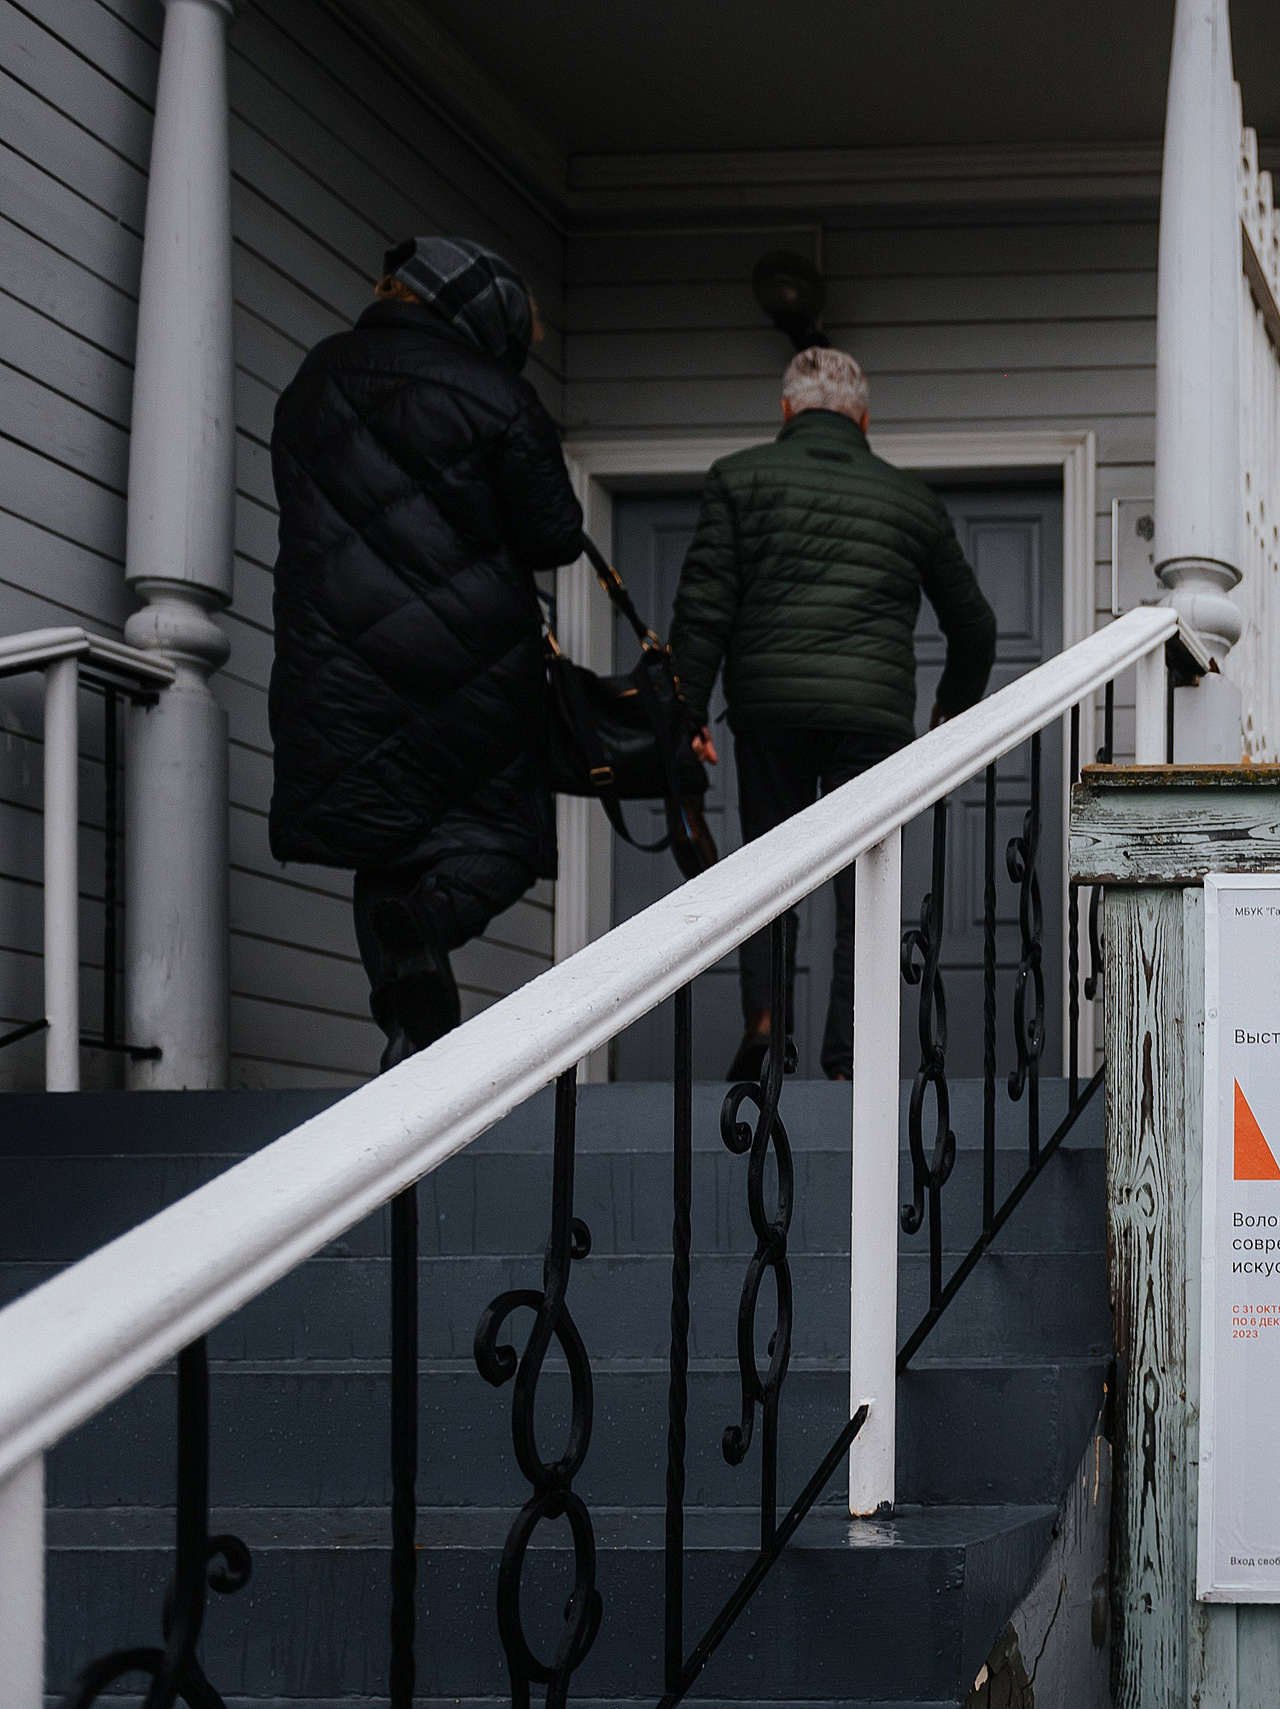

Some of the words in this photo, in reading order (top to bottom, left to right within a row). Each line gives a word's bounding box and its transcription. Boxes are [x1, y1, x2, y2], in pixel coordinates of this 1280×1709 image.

[1234, 907, 1263, 917] МБУК
[1232, 1304, 1240, 1314] С
[1242, 1304, 1254, 1314] 31
[1232, 1317, 1248, 1327] ПО
[1249, 1317, 1257, 1327] 6
[1232, 1329, 1259, 1339] 2023
[1230, 1556, 1255, 1568] Вход
